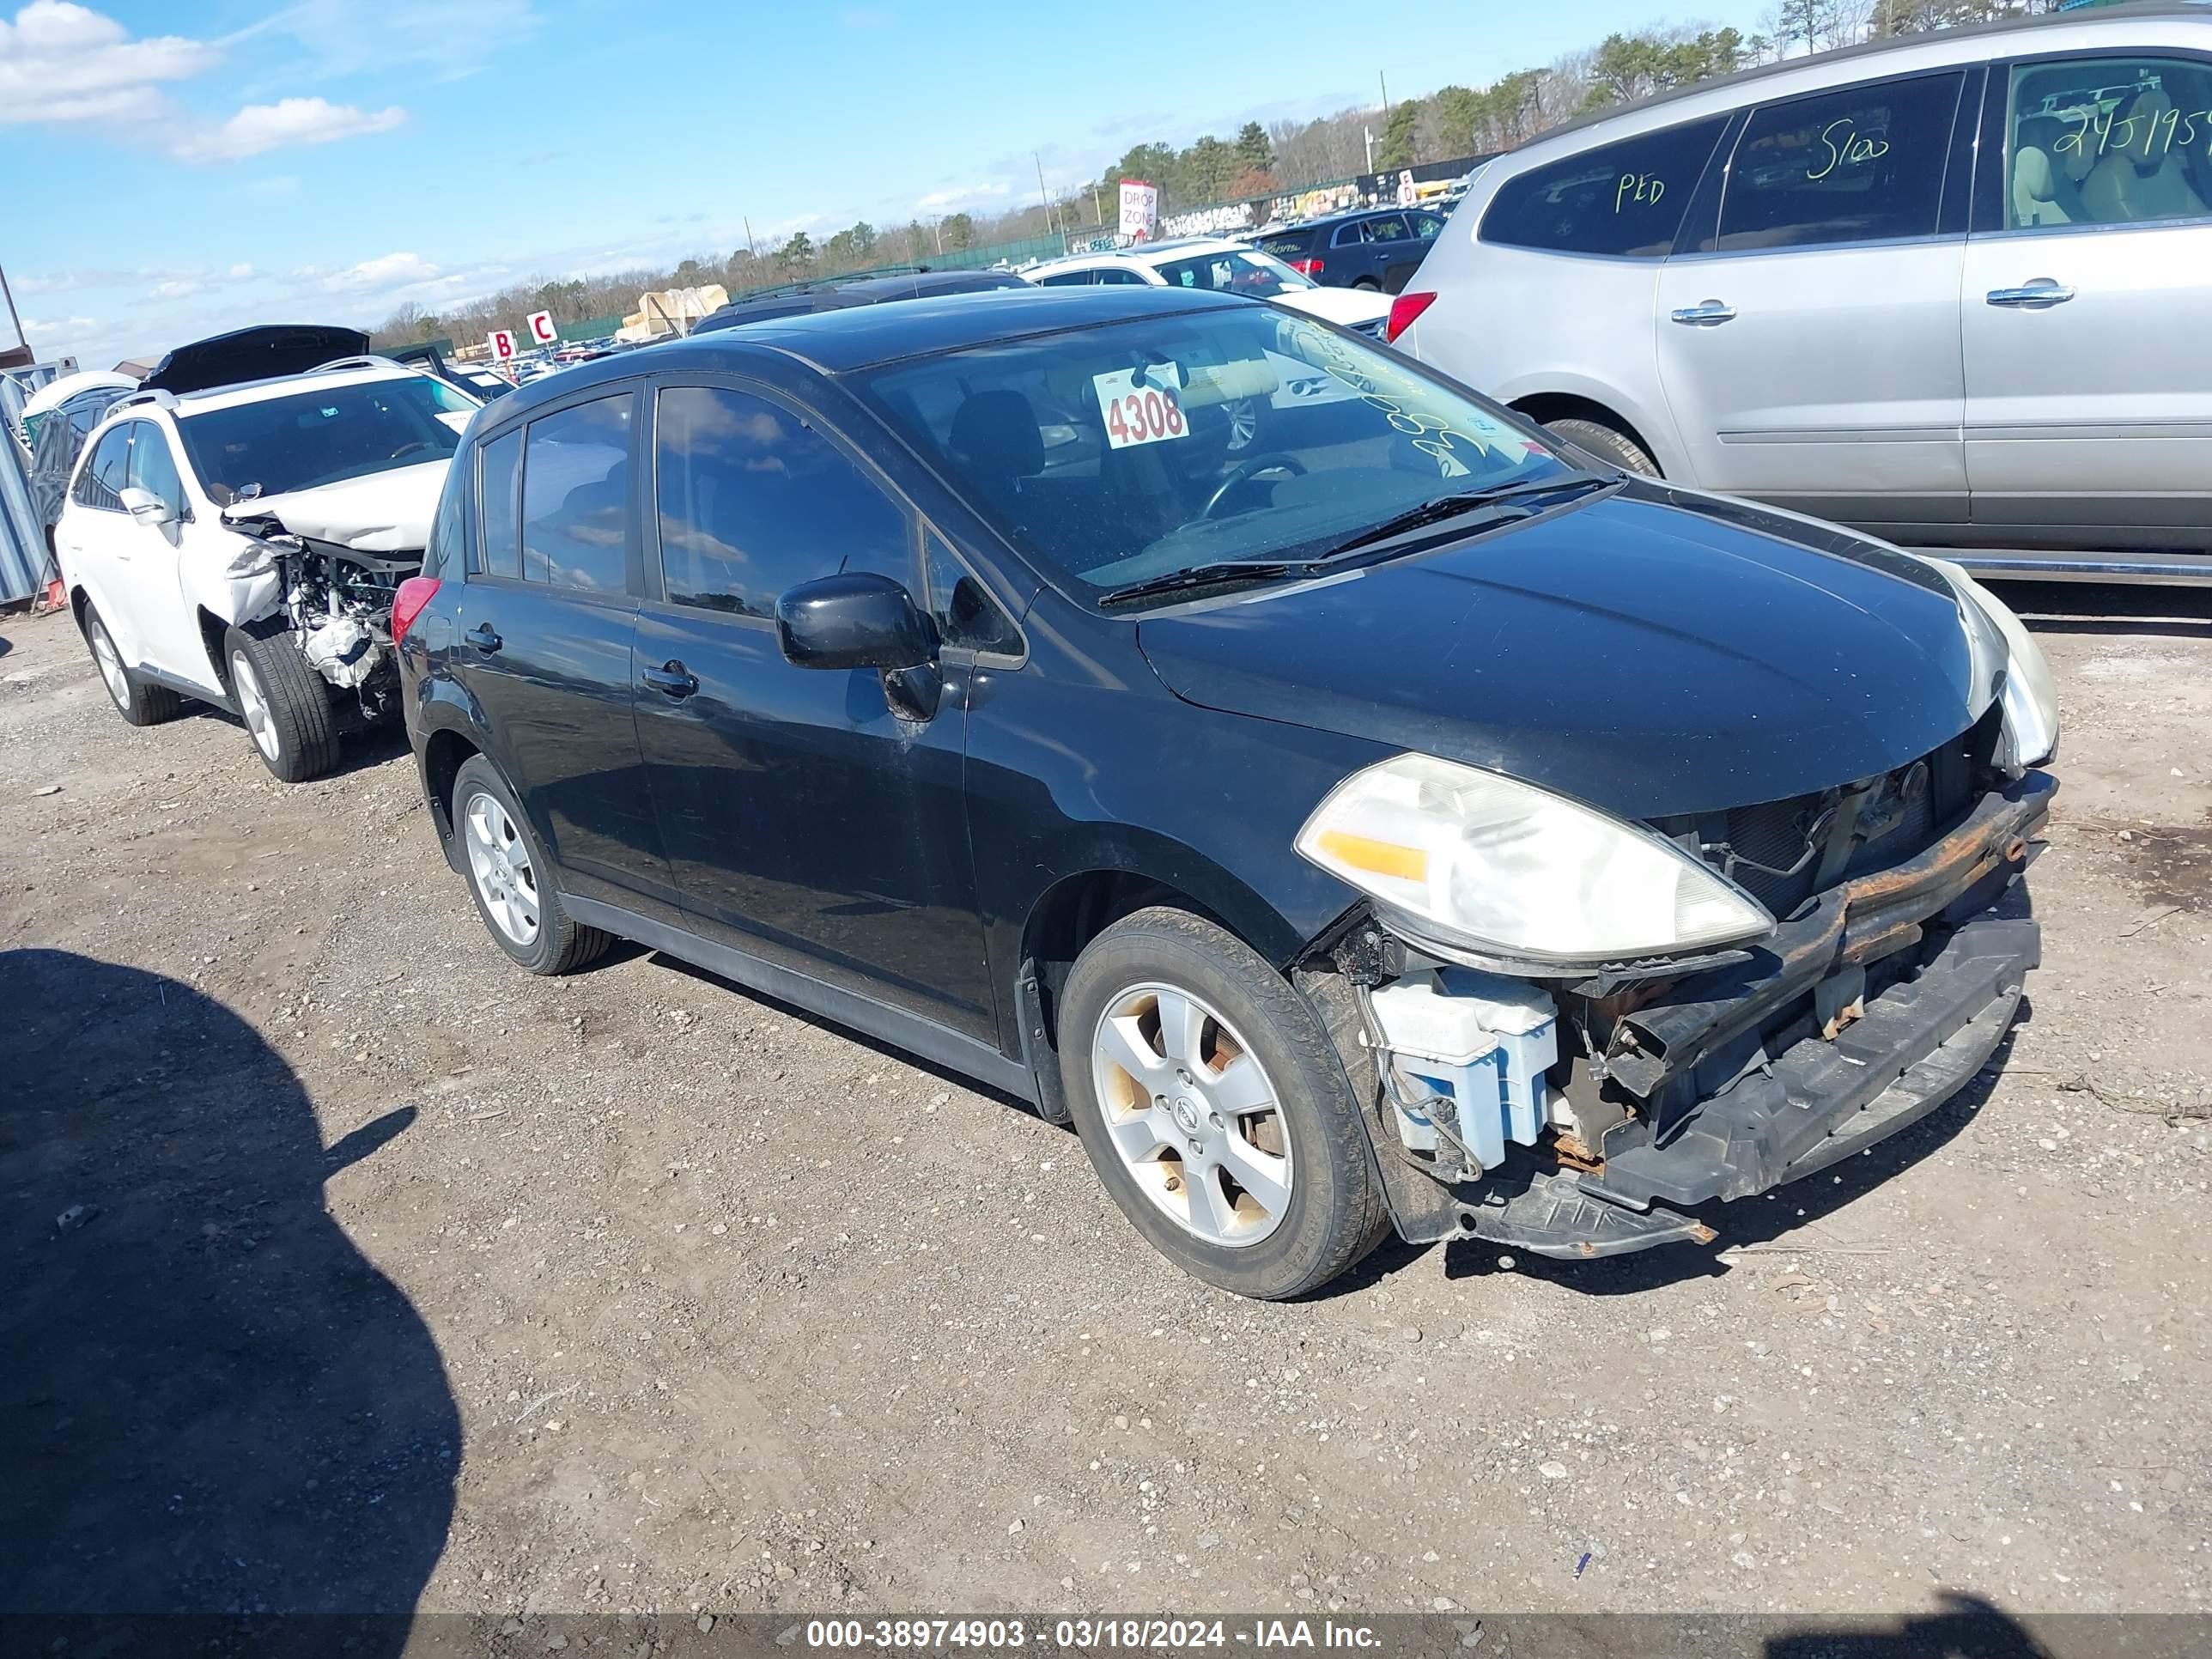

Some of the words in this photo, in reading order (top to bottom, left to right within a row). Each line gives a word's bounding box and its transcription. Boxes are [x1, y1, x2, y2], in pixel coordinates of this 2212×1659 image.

[2054, 108, 2212, 156] 245195
[1124, 191, 1154, 207] DROP
[1124, 209, 1153, 228] ZONE
[534, 315, 552, 340] C
[495, 333, 512, 358] B
[1109, 387, 1183, 445] 4308
